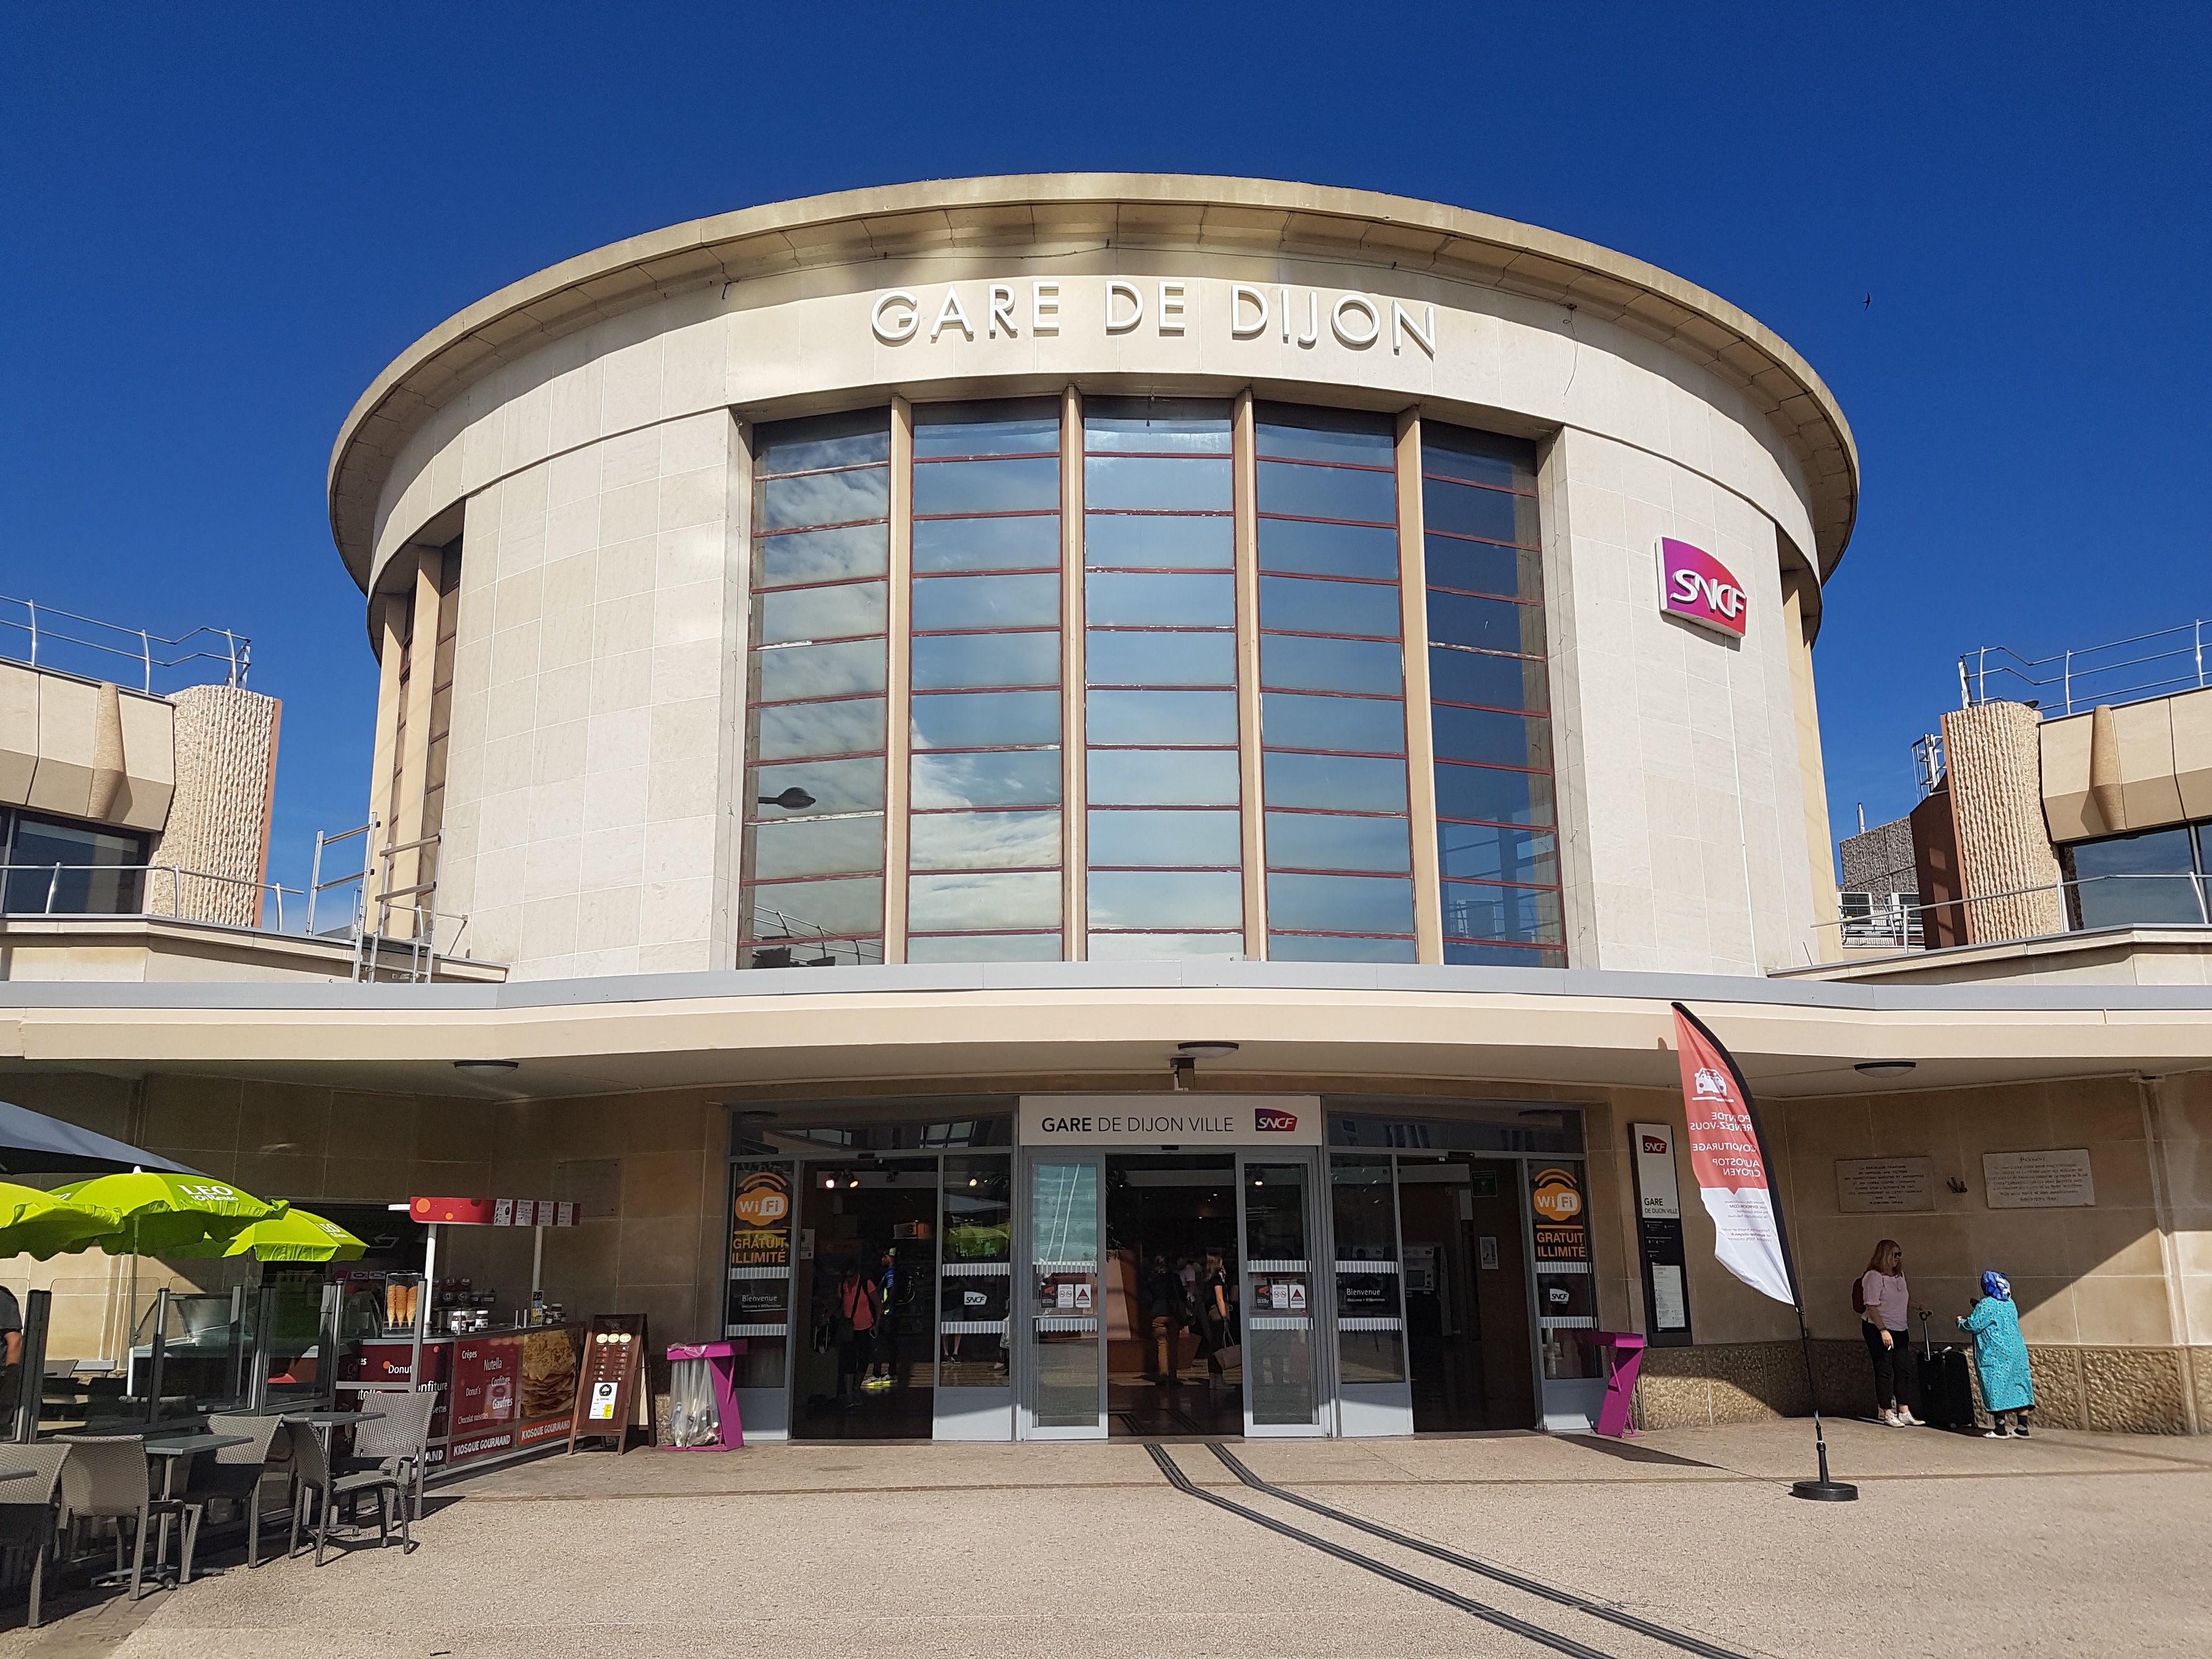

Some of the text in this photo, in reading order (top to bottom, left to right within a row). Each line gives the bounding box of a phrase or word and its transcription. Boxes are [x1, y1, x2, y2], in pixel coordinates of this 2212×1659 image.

[871, 280, 1436, 355] GARE DE DIJON
[1670, 569, 1746, 618] SNCF
[1042, 1116, 1233, 1132] GARE DE DIJON VILLE
[1257, 1117, 1295, 1129] SNCF
[1644, 1142, 1666, 1152] SNCF
[177, 1184, 233, 1195] LEO
[1644, 1198, 1663, 1206] GARE
[733, 1237, 787, 1249] GRATUIT
[1537, 1232, 1584, 1243] GRATUIT
[732, 1249, 786, 1263] ILLIMITÉ
[1538, 1244, 1586, 1257] ILLIMITÉ
[462, 1350, 477, 1361] Crêpes
[388, 1364, 411, 1374] Donut
[484, 1357, 503, 1372] Nutella
[418, 1380, 448, 1392] nfiture
[492, 1375, 511, 1387] Confiture
[492, 1396, 513, 1409] Gaufres
[458, 1413, 473, 1425] Chocolat
[522, 1420, 571, 1441] KIOSQUE GOURMAND
[453, 1441, 479, 1457] KIOSQUE
[480, 1435, 511, 1450] GOURMAND
